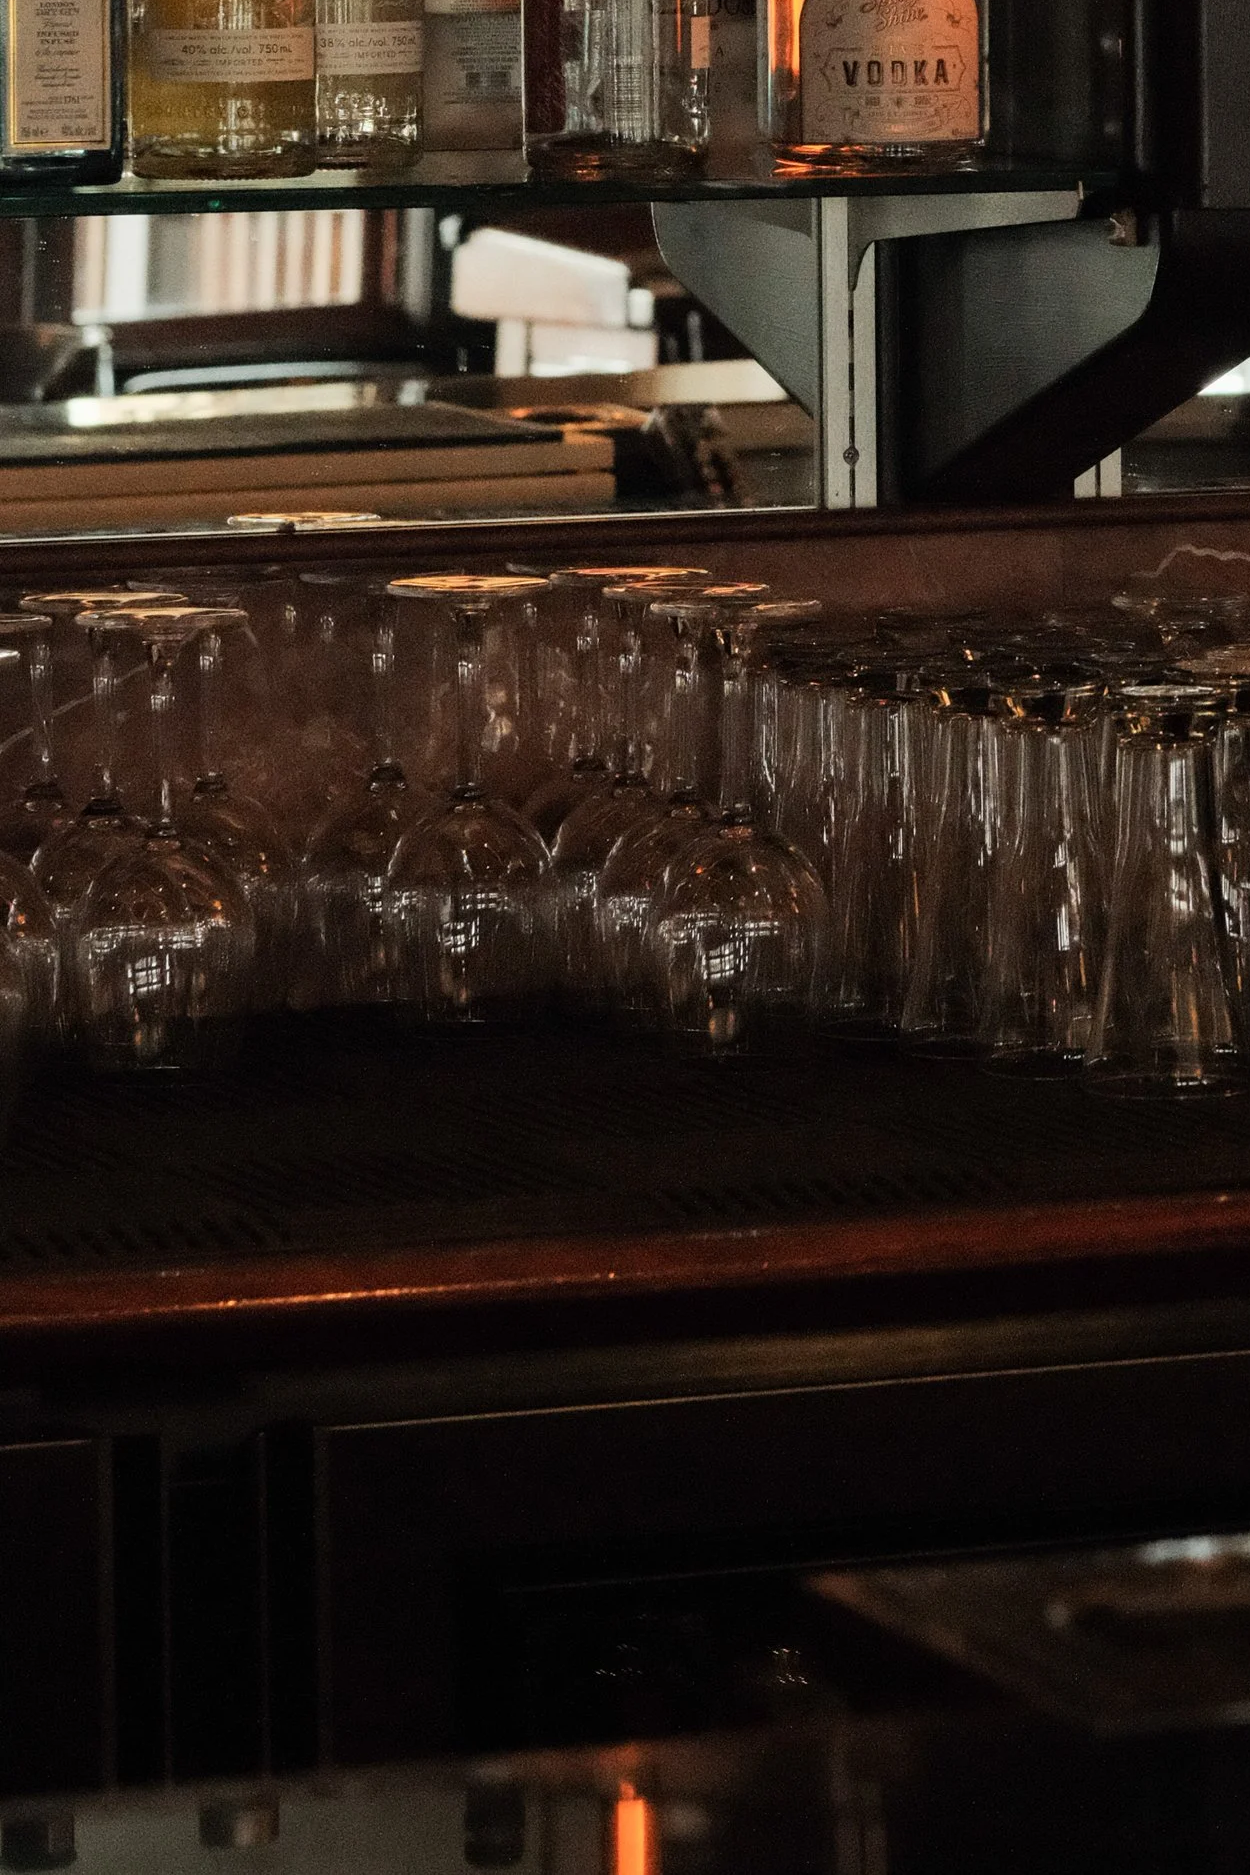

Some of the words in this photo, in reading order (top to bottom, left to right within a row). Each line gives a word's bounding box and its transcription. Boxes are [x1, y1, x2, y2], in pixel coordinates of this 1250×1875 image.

[181, 44, 207, 55] 40%
[215, 58, 264, 67] IMPORTED
[842, 58, 950, 87] VODKA
